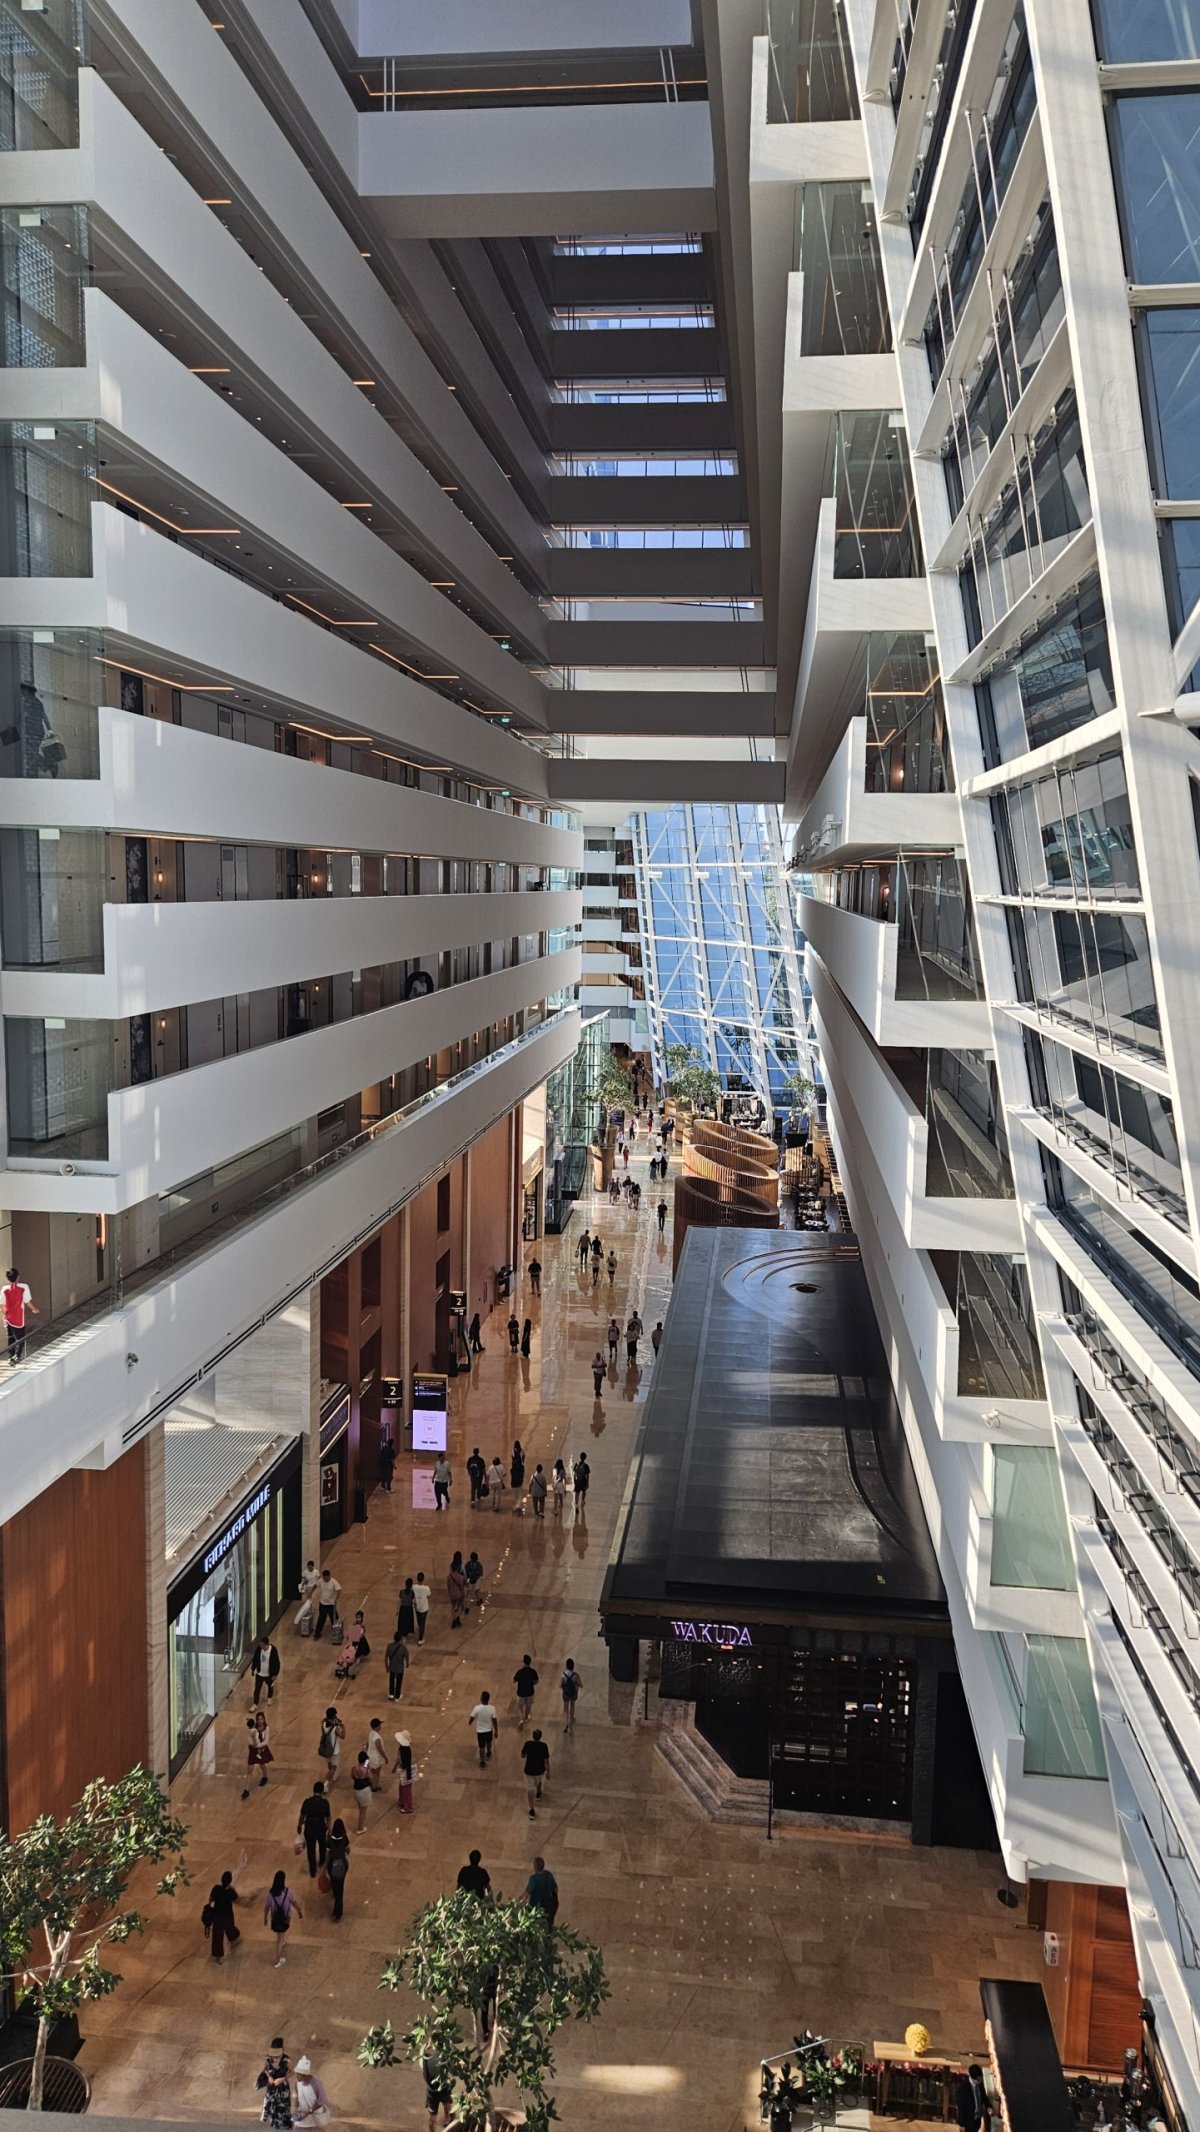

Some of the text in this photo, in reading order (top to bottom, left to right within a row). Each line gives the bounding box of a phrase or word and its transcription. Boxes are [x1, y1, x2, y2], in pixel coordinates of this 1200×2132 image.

[456, 1297, 462, 1306] 2
[390, 1386, 397, 1396] 2
[670, 1621, 753, 1646] WAKUDA
